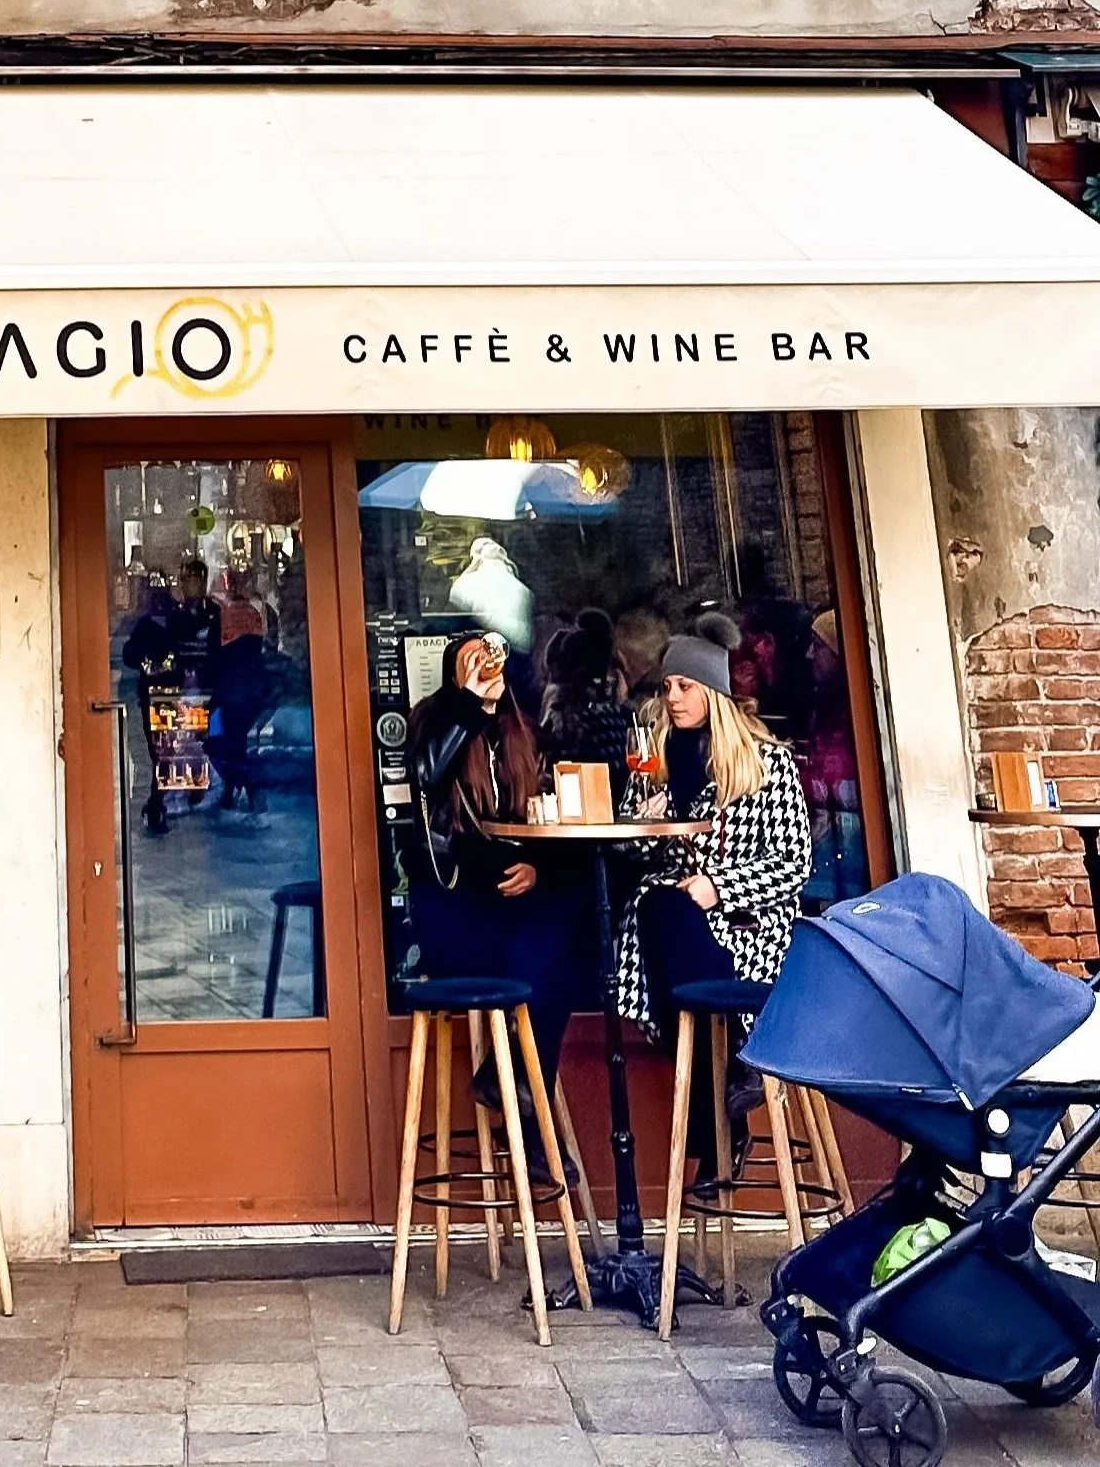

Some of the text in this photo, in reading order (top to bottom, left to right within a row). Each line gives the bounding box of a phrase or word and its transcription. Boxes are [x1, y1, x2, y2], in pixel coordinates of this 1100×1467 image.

[343, 327, 870, 364] CAFFÈ & WINE BAR
